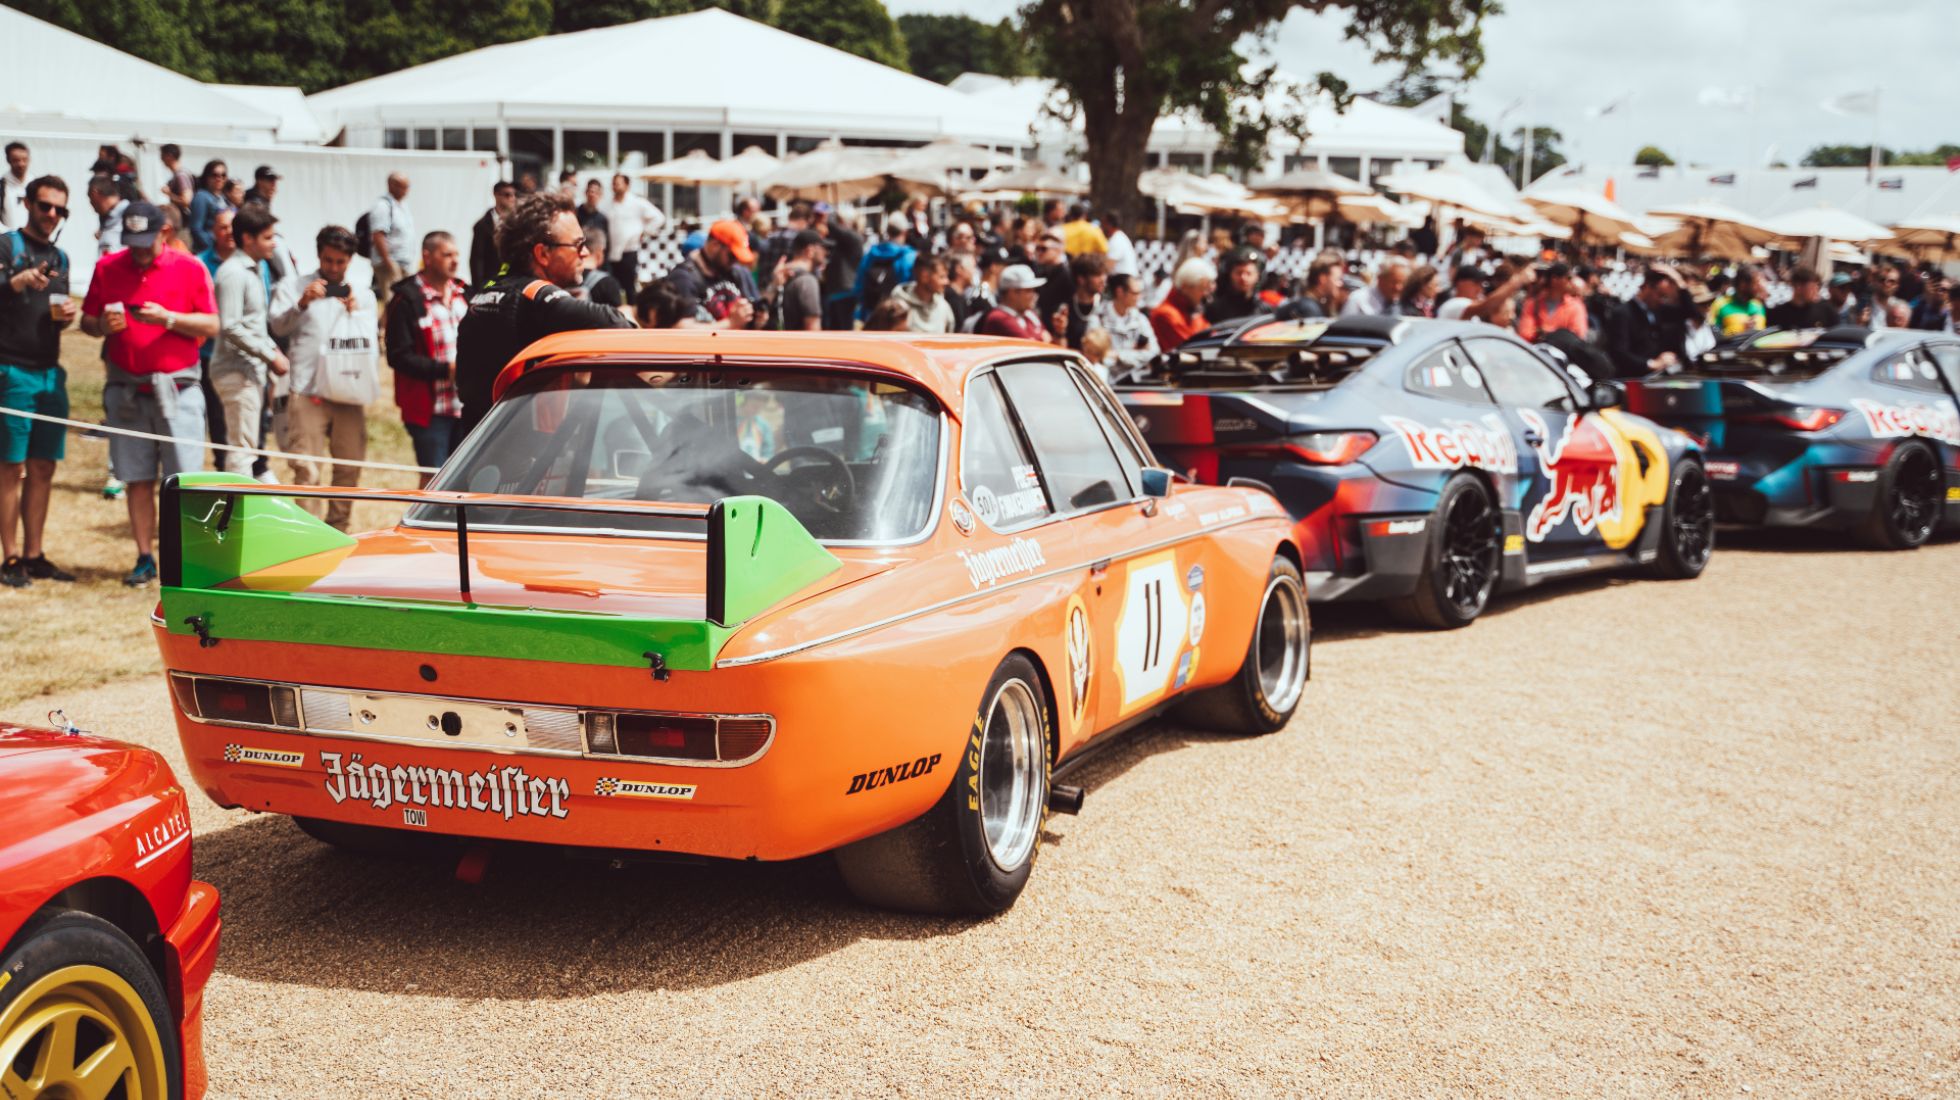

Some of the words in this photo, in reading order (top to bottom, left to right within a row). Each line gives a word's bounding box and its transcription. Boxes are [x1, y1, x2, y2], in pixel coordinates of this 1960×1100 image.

[1143, 579, 1161, 672] 11
[244, 750, 300, 763] DUNLOP
[845, 753, 941, 795] DUNLOP
[968, 712, 984, 811] EAGLE
[620, 783, 692, 796] DUNLOP
[136, 812, 187, 856] ALCATEL
[404, 810, 426, 826] TOW
